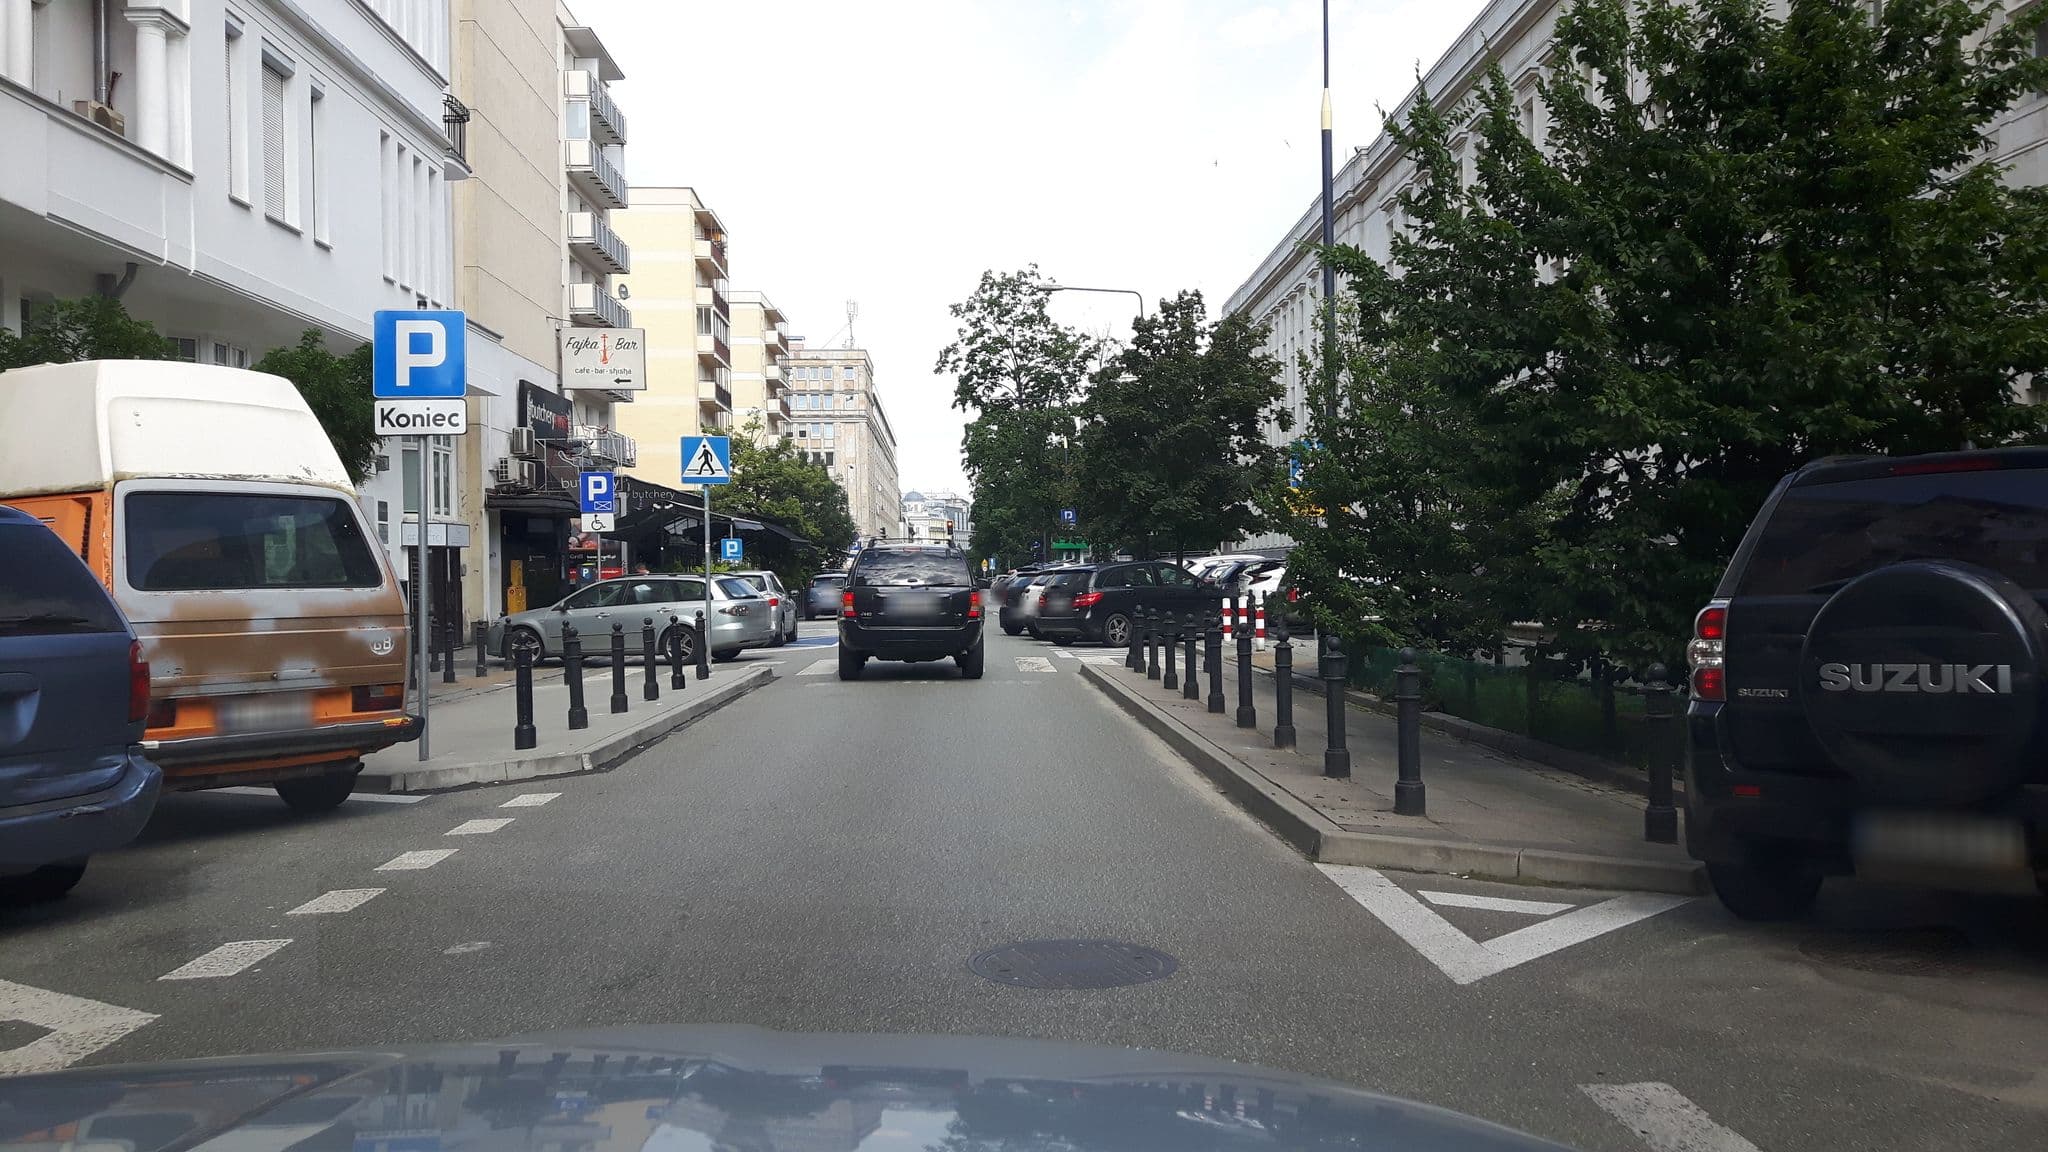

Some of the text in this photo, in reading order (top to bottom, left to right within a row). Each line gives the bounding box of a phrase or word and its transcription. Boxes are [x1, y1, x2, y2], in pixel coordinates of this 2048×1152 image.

[395, 319, 446, 387] P
[565, 337, 639, 356] Fajka Bar
[380, 407, 460, 428] Koniec
[588, 476, 607, 501] P
[632, 490, 675, 500] butchery
[1819, 663, 2013, 694] SUZUKI
[1737, 688, 1789, 698] SUZUKI
